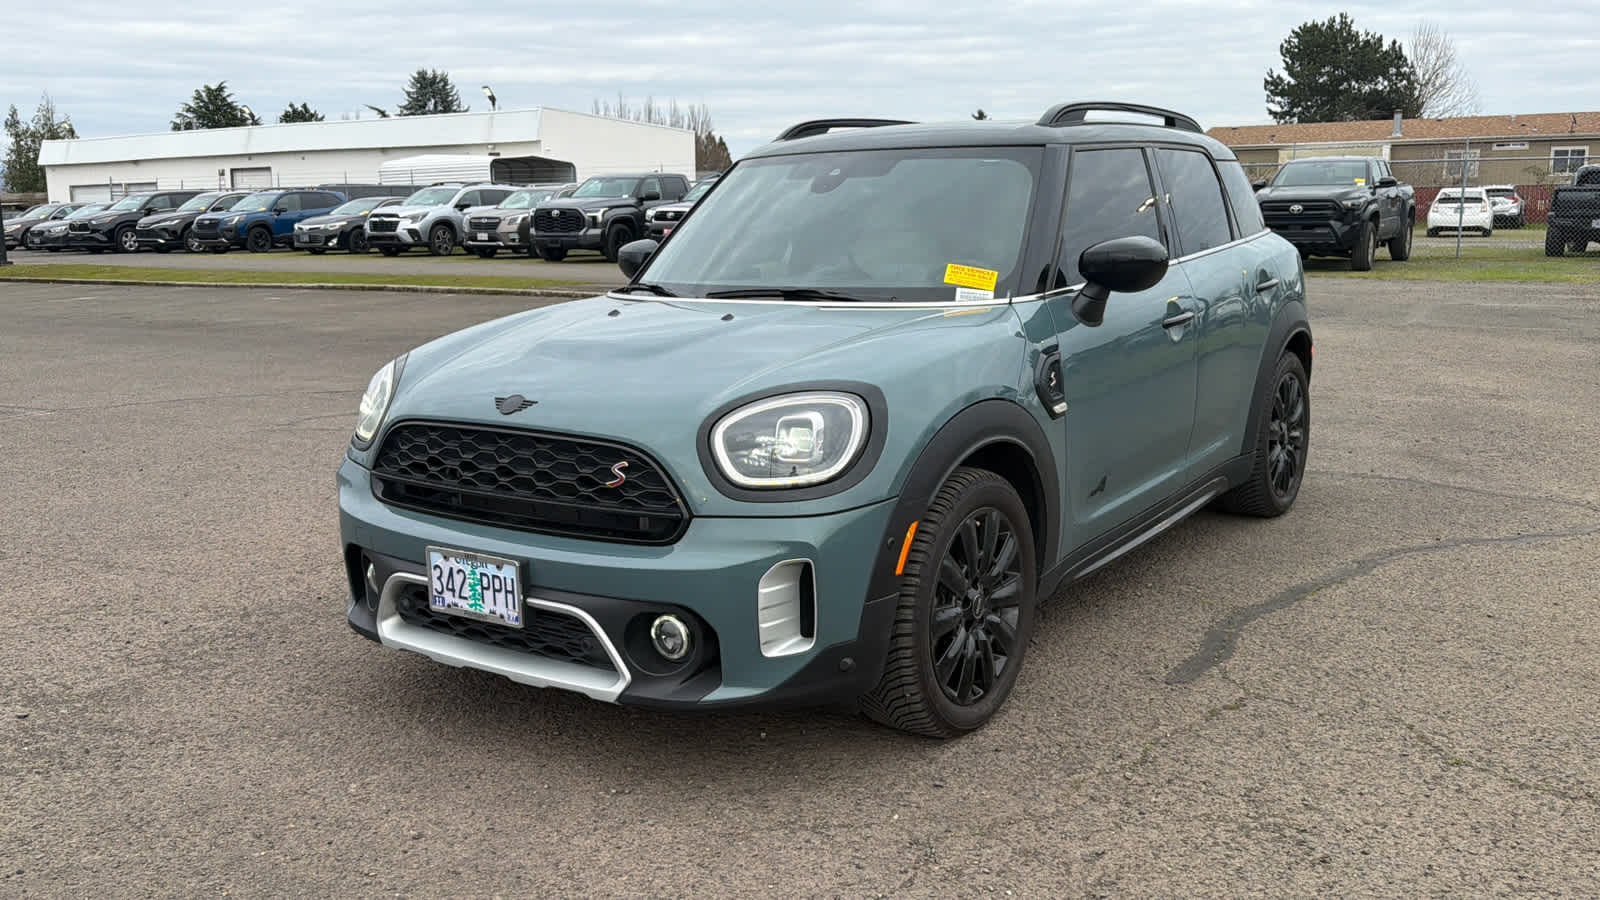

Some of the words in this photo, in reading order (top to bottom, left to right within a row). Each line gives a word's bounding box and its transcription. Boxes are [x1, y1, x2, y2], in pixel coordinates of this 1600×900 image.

[605, 461, 629, 488] S
[433, 564, 468, 600] 342
[479, 572, 516, 610] PPH
